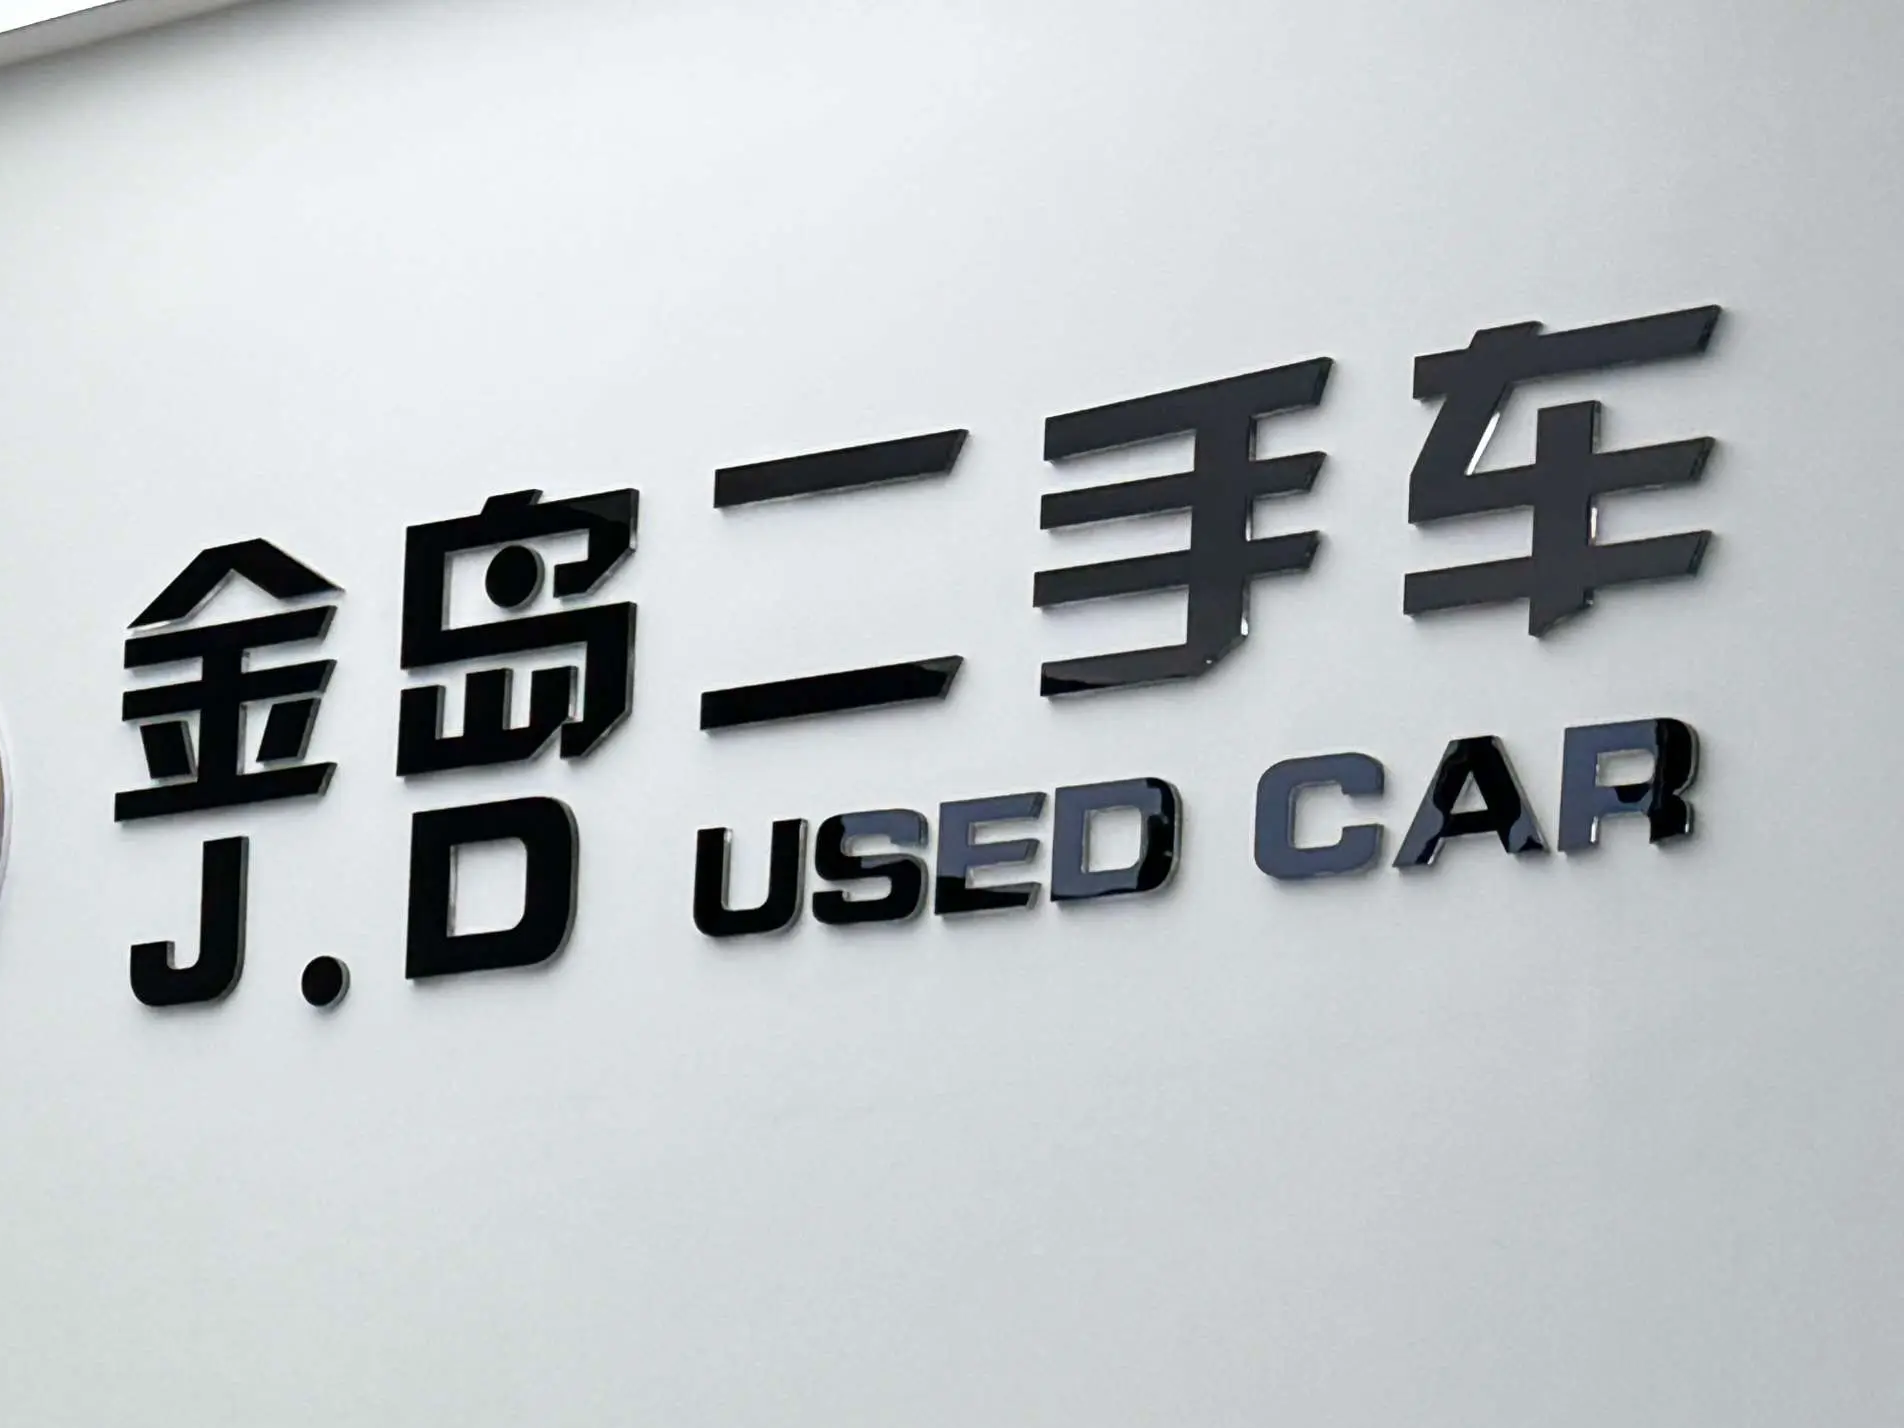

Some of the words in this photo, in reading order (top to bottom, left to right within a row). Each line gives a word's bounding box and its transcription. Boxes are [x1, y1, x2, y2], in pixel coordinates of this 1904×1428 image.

[114, 305, 1725, 824] 金岛二手车
[694, 777, 1183, 942] USED
[1255, 718, 1703, 884] CAR
